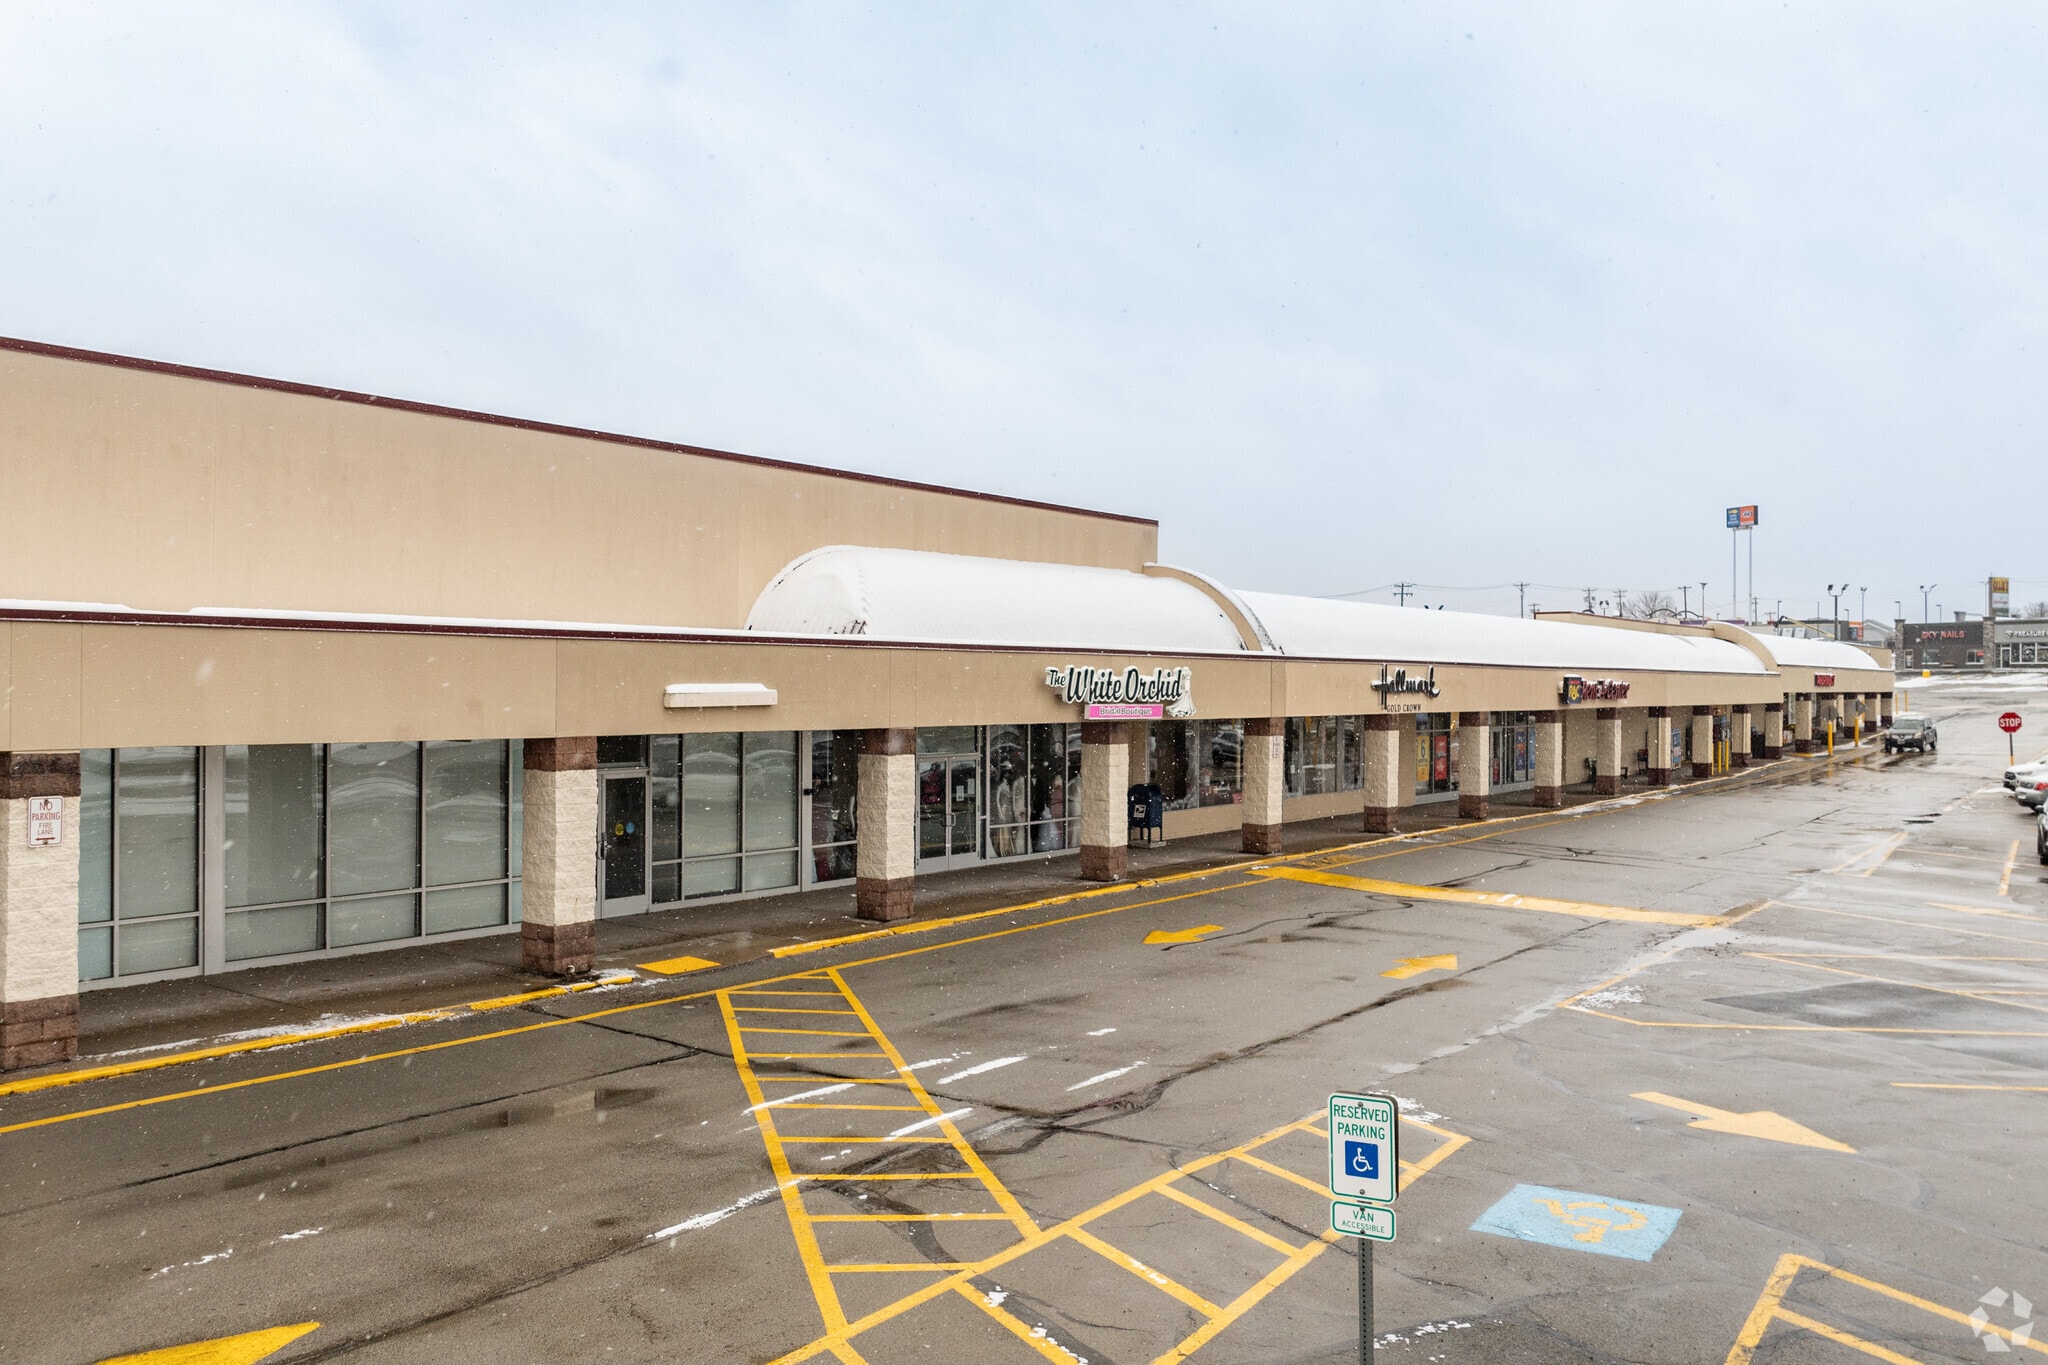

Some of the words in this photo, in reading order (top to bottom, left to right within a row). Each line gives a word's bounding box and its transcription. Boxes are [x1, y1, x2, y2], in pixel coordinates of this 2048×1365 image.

[1921, 630, 1938, 639] SKY
[1941, 630, 1965, 639] NAILS
[1049, 669, 1066, 686] The
[1066, 667, 1122, 703] White
[1124, 668, 1182, 701] Orchid
[1370, 664, 1441, 710] Hallmark
[1100, 706, 1121, 715] Bridal
[1121, 706, 1153, 717] Boutique
[1387, 704, 1402, 712] GOLD
[1402, 703, 1422, 712] CROWN
[1999, 718, 2021, 727] STOP
[39, 802, 53, 811] NO
[31, 812, 60, 821] PARKING
[1333, 1104, 1389, 1123] RESERVED
[1337, 1122, 1385, 1140] PARKING
[1352, 1210, 1375, 1222] VAN
[1341, 1220, 1385, 1234] ACCESSIBLE
